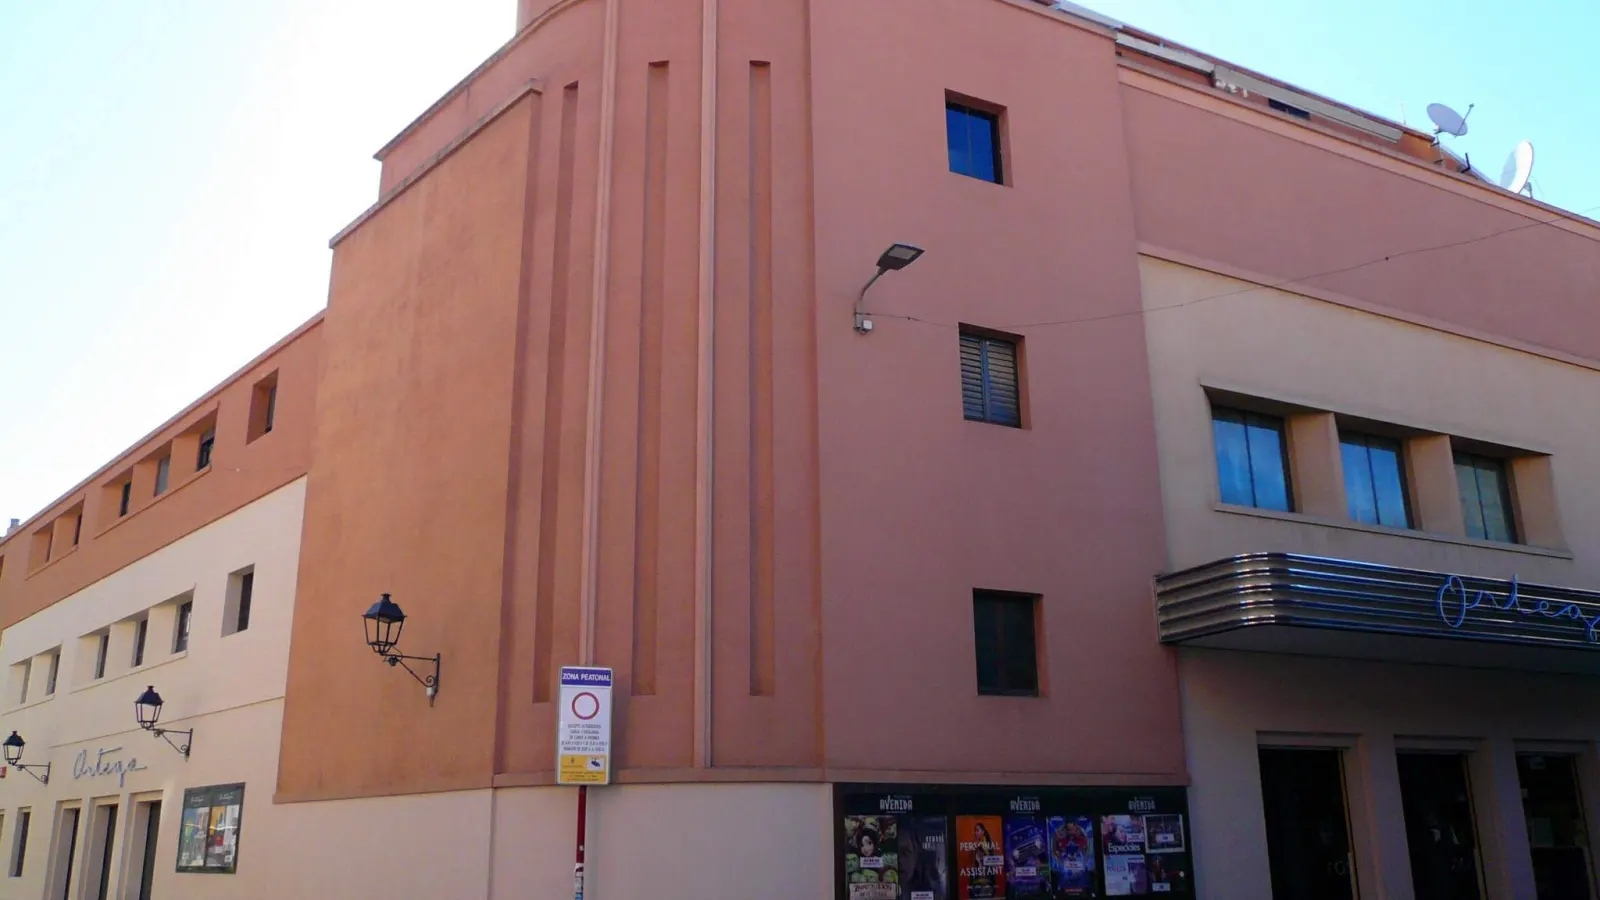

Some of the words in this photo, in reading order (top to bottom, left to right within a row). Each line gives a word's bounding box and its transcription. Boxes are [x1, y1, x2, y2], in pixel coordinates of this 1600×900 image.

[1438, 573, 1600, 642] Orteg
[562, 672, 580, 681] ZONA
[581, 673, 611, 682] PEATONAL
[880, 795, 913, 811] AVENIDA
[1010, 796, 1041, 811] AVENIDA
[1128, 797, 1156, 811] AVENIDA
[960, 841, 1000, 852] PERSONAL
[960, 866, 1004, 877] ASSISTANT
